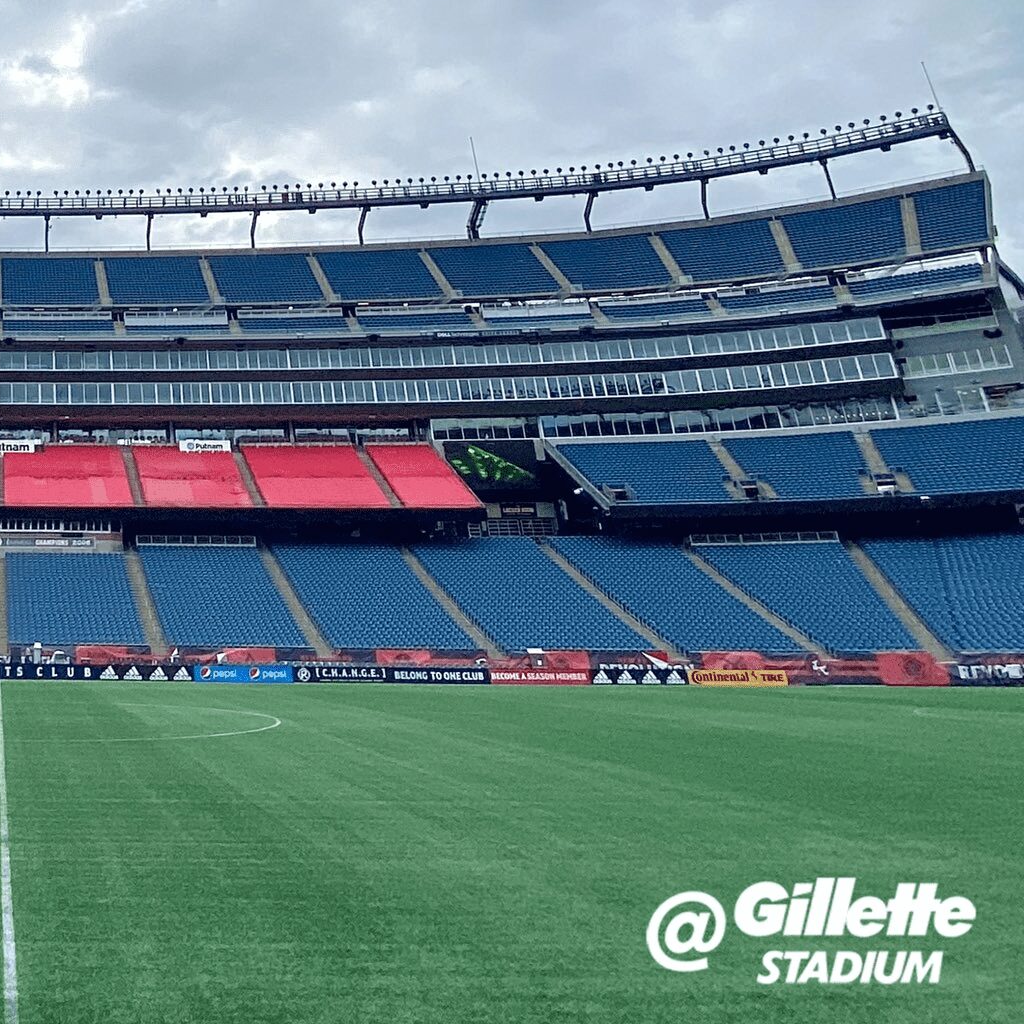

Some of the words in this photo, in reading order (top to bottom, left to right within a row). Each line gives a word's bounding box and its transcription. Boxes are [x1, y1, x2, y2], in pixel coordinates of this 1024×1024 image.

[36, 666, 91, 677] CLUB
[212, 669, 237, 679] pepsi
[262, 670, 287, 680] pepsi
[394, 670, 427, 680] BELONG
[430, 671, 442, 680] TO
[443, 671, 462, 680] ONE
[463, 671, 484, 680] CLUB
[491, 672, 521, 681] BECOME
[527, 672, 555, 681] SEASON
[556, 672, 588, 681] MEMBER
[691, 670, 749, 683] Continental
[760, 673, 784, 682] TIRE
